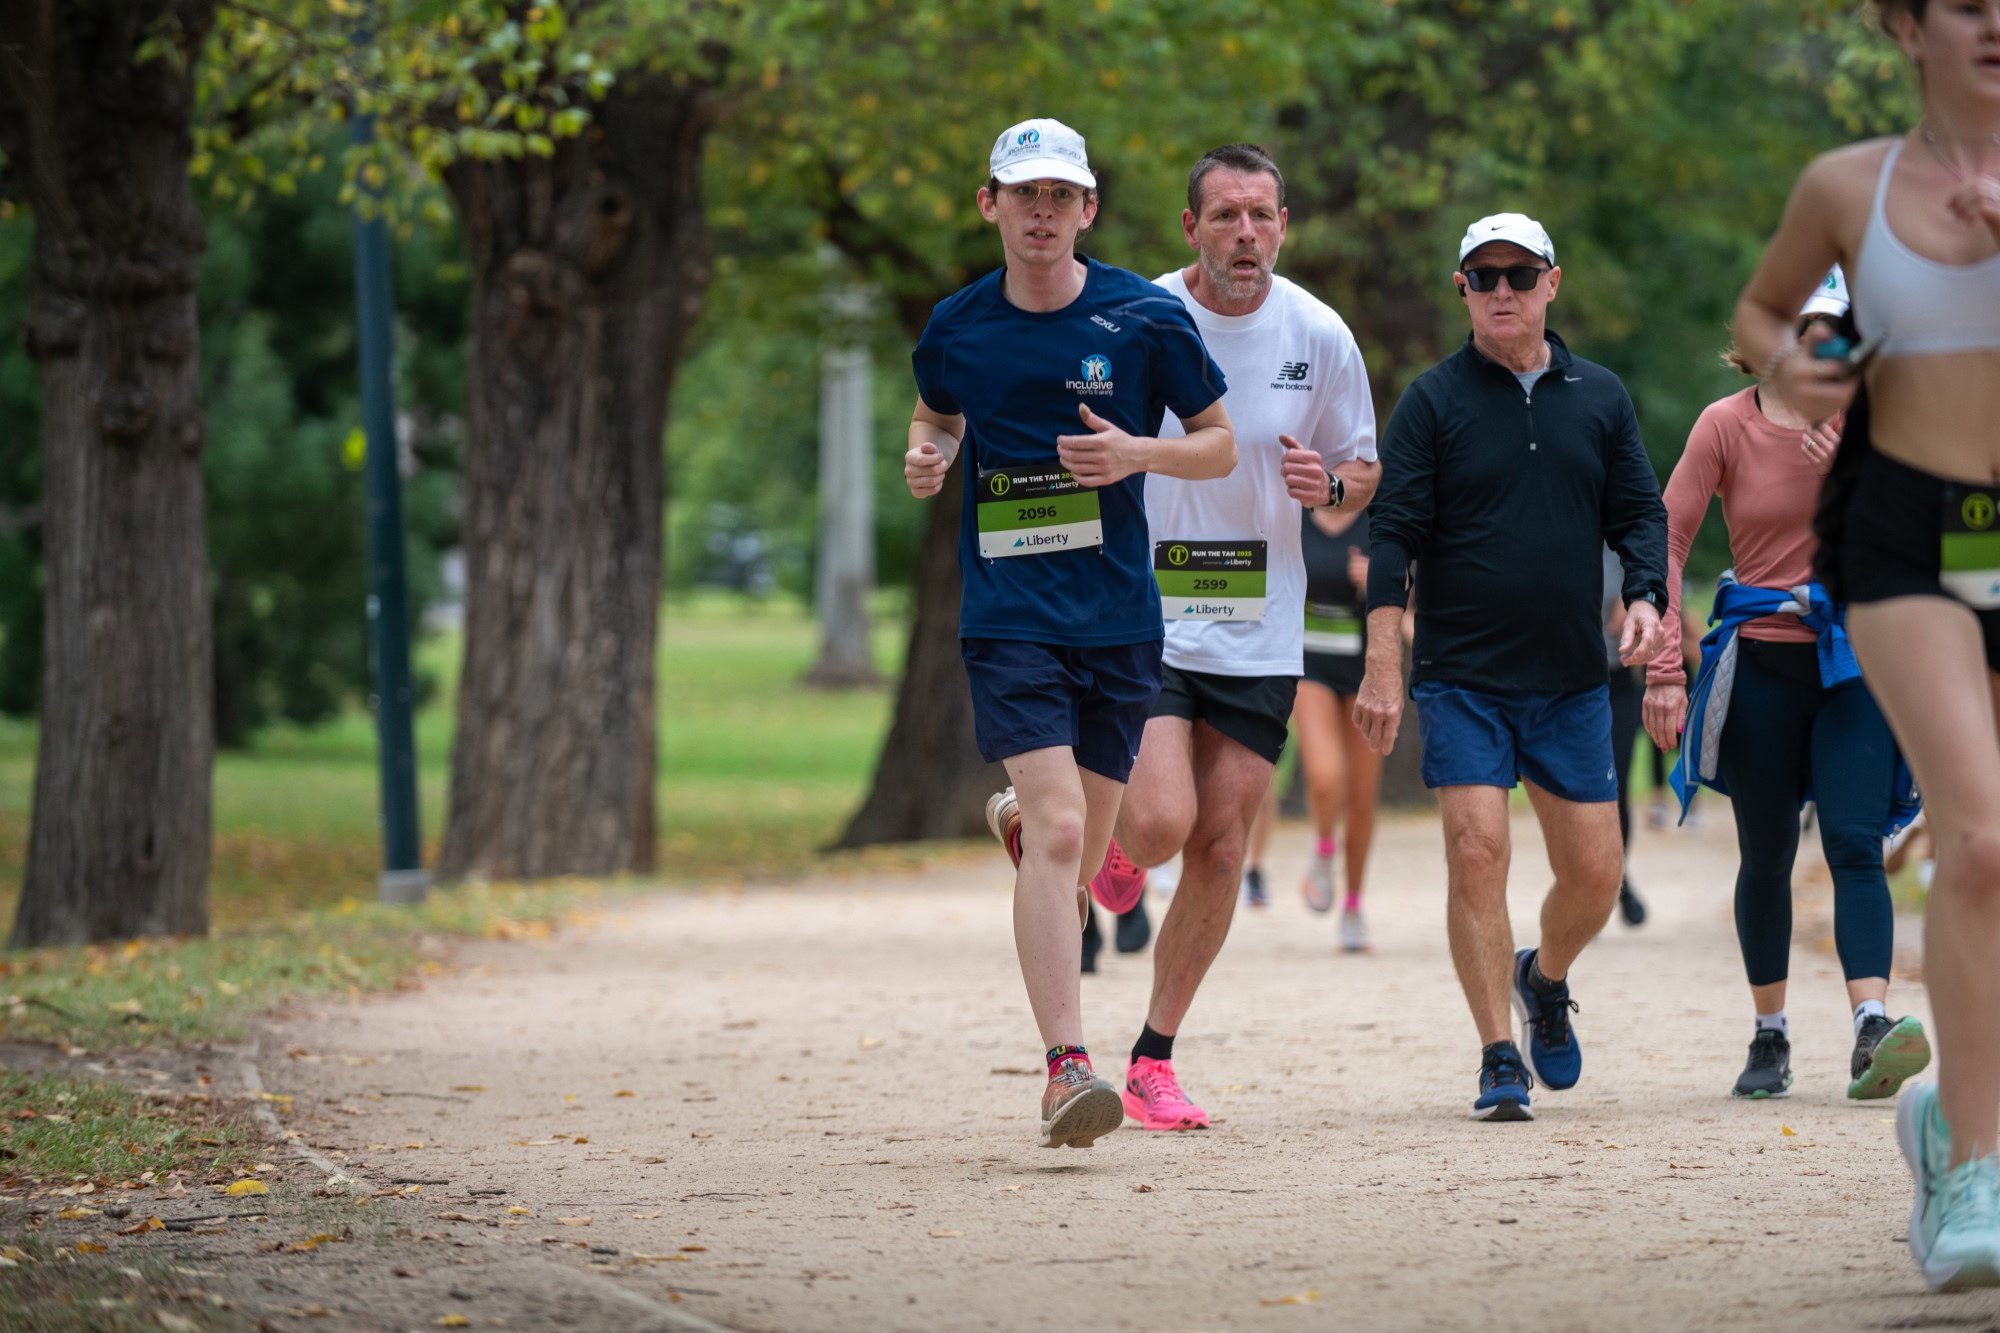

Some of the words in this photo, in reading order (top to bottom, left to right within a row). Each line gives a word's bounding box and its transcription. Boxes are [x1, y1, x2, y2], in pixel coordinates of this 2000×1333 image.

[1090, 314, 1121, 333] 2XU
[1076, 389, 1093, 397] sports
[1094, 389, 1113, 397] training
[1012, 476, 1028, 485] RUN
[1029, 475, 1043, 483] THE
[1044, 473, 1060, 481] TAN
[1055, 481, 1079, 490] Liberty
[1017, 505, 1057, 521] 2096
[1026, 533, 1069, 547] Liberty
[1230, 558, 1252, 567] Liberty
[1193, 579, 1228, 590] 2599
[1196, 604, 1235, 616] Liberty
